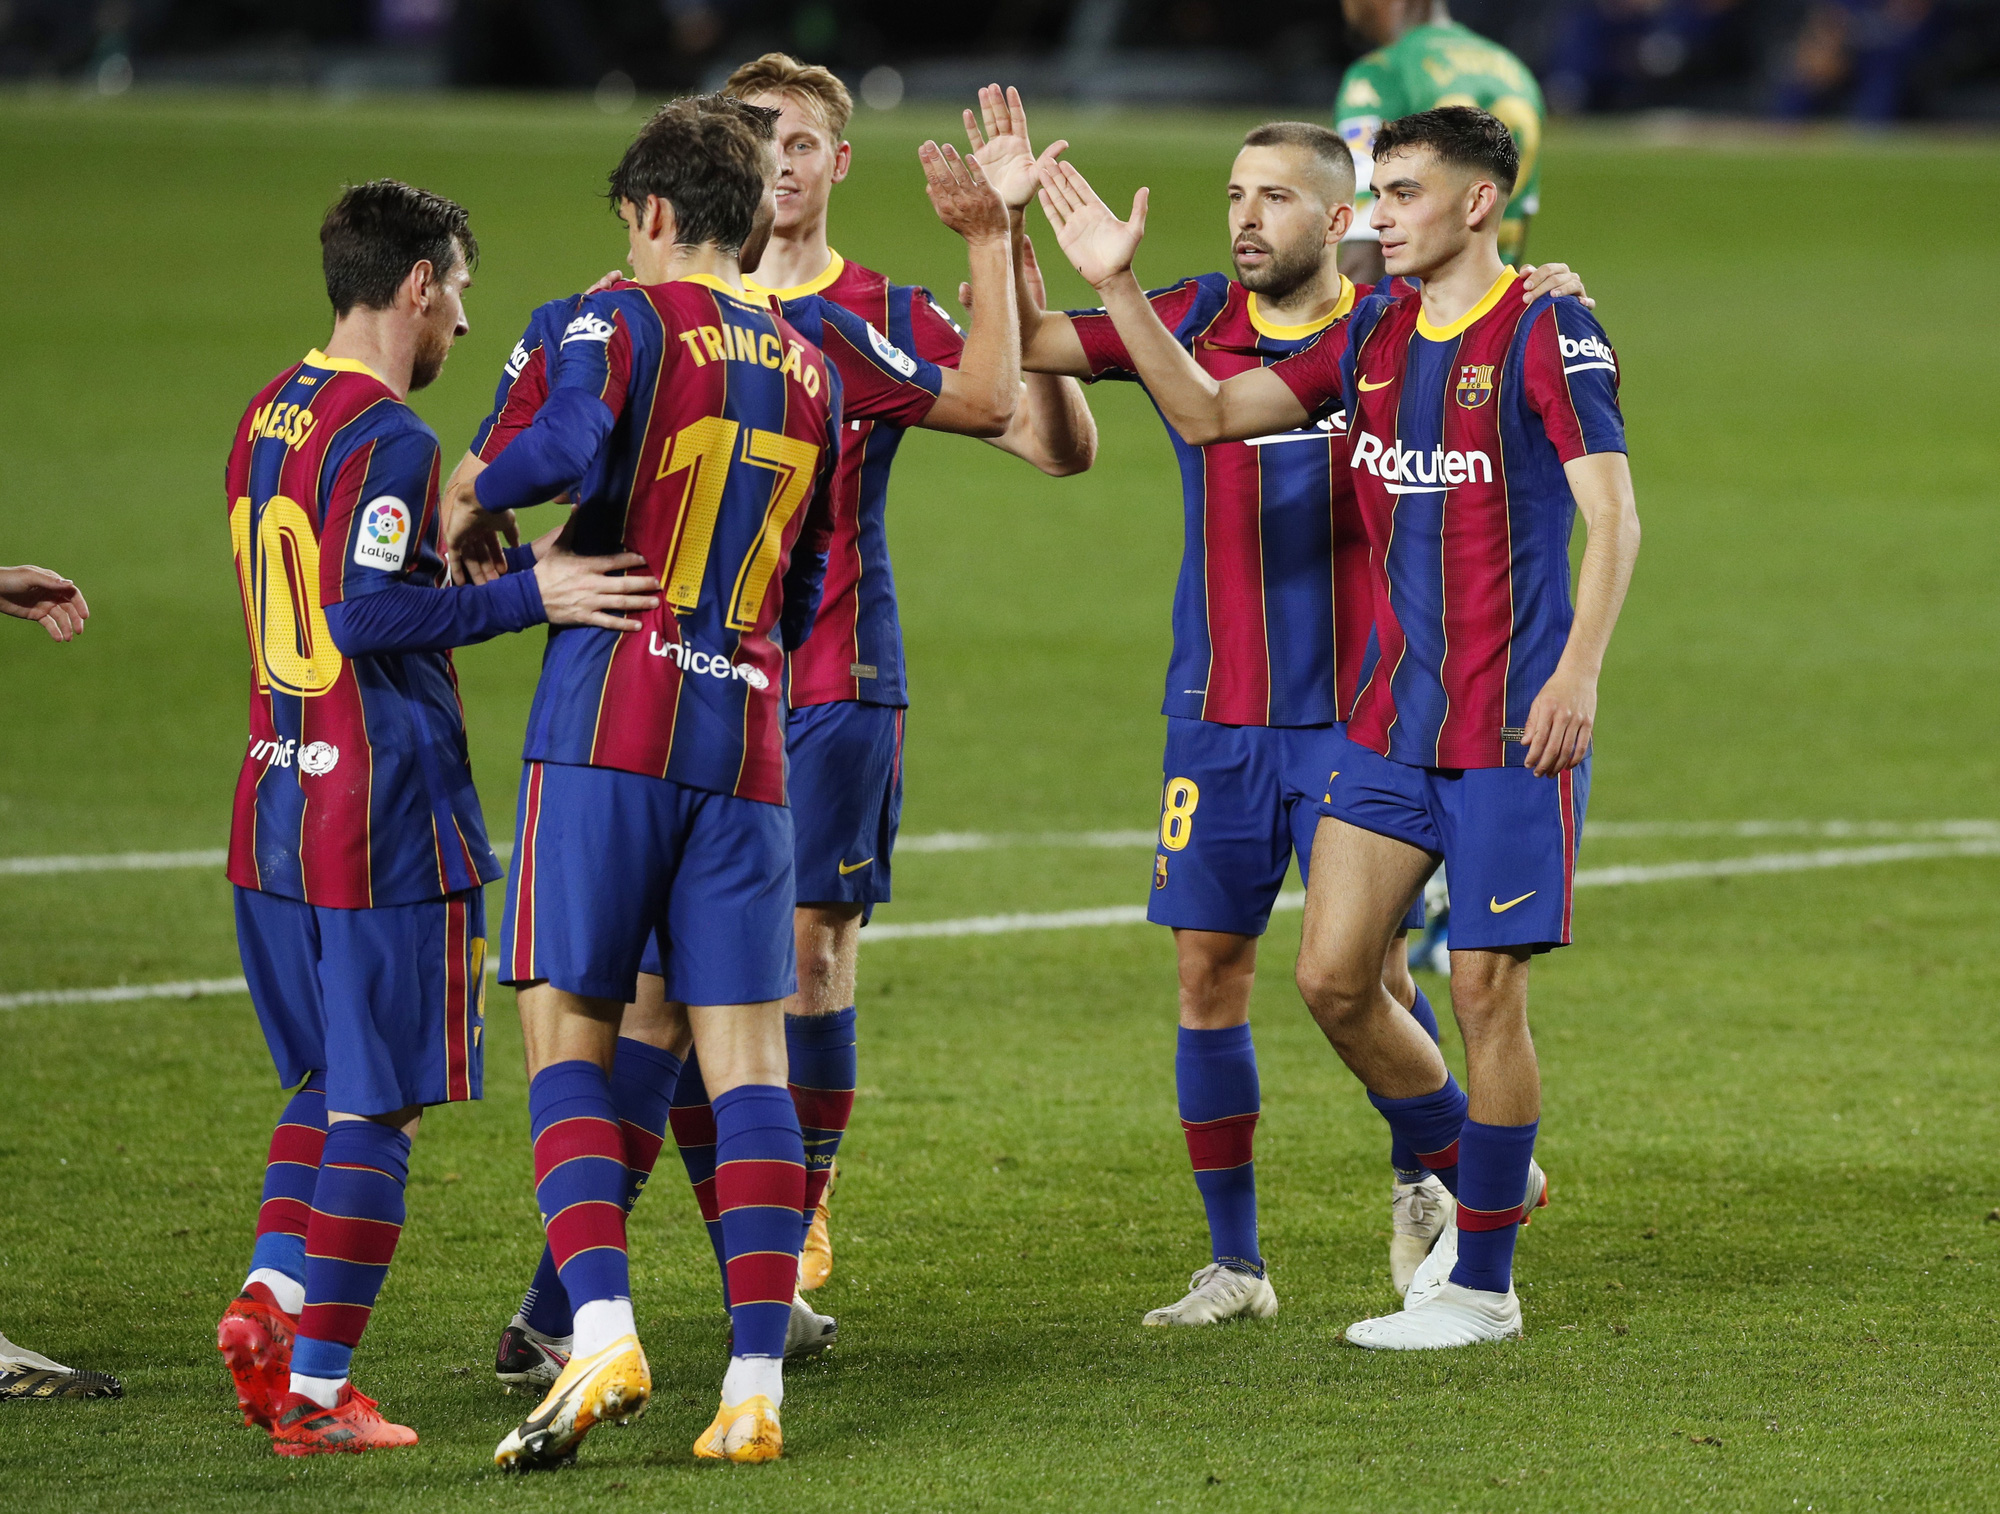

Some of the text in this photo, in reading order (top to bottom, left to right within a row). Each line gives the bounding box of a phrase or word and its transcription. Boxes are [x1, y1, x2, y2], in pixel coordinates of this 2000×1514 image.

[678, 322, 820, 398] TRINCÃO
[1558, 335, 1615, 364] beko
[1350, 430, 1493, 484] Rakuten
[361, 545, 400, 563] LaLiga
[655, 415, 820, 632] 17
[230, 495, 343, 698] 10
